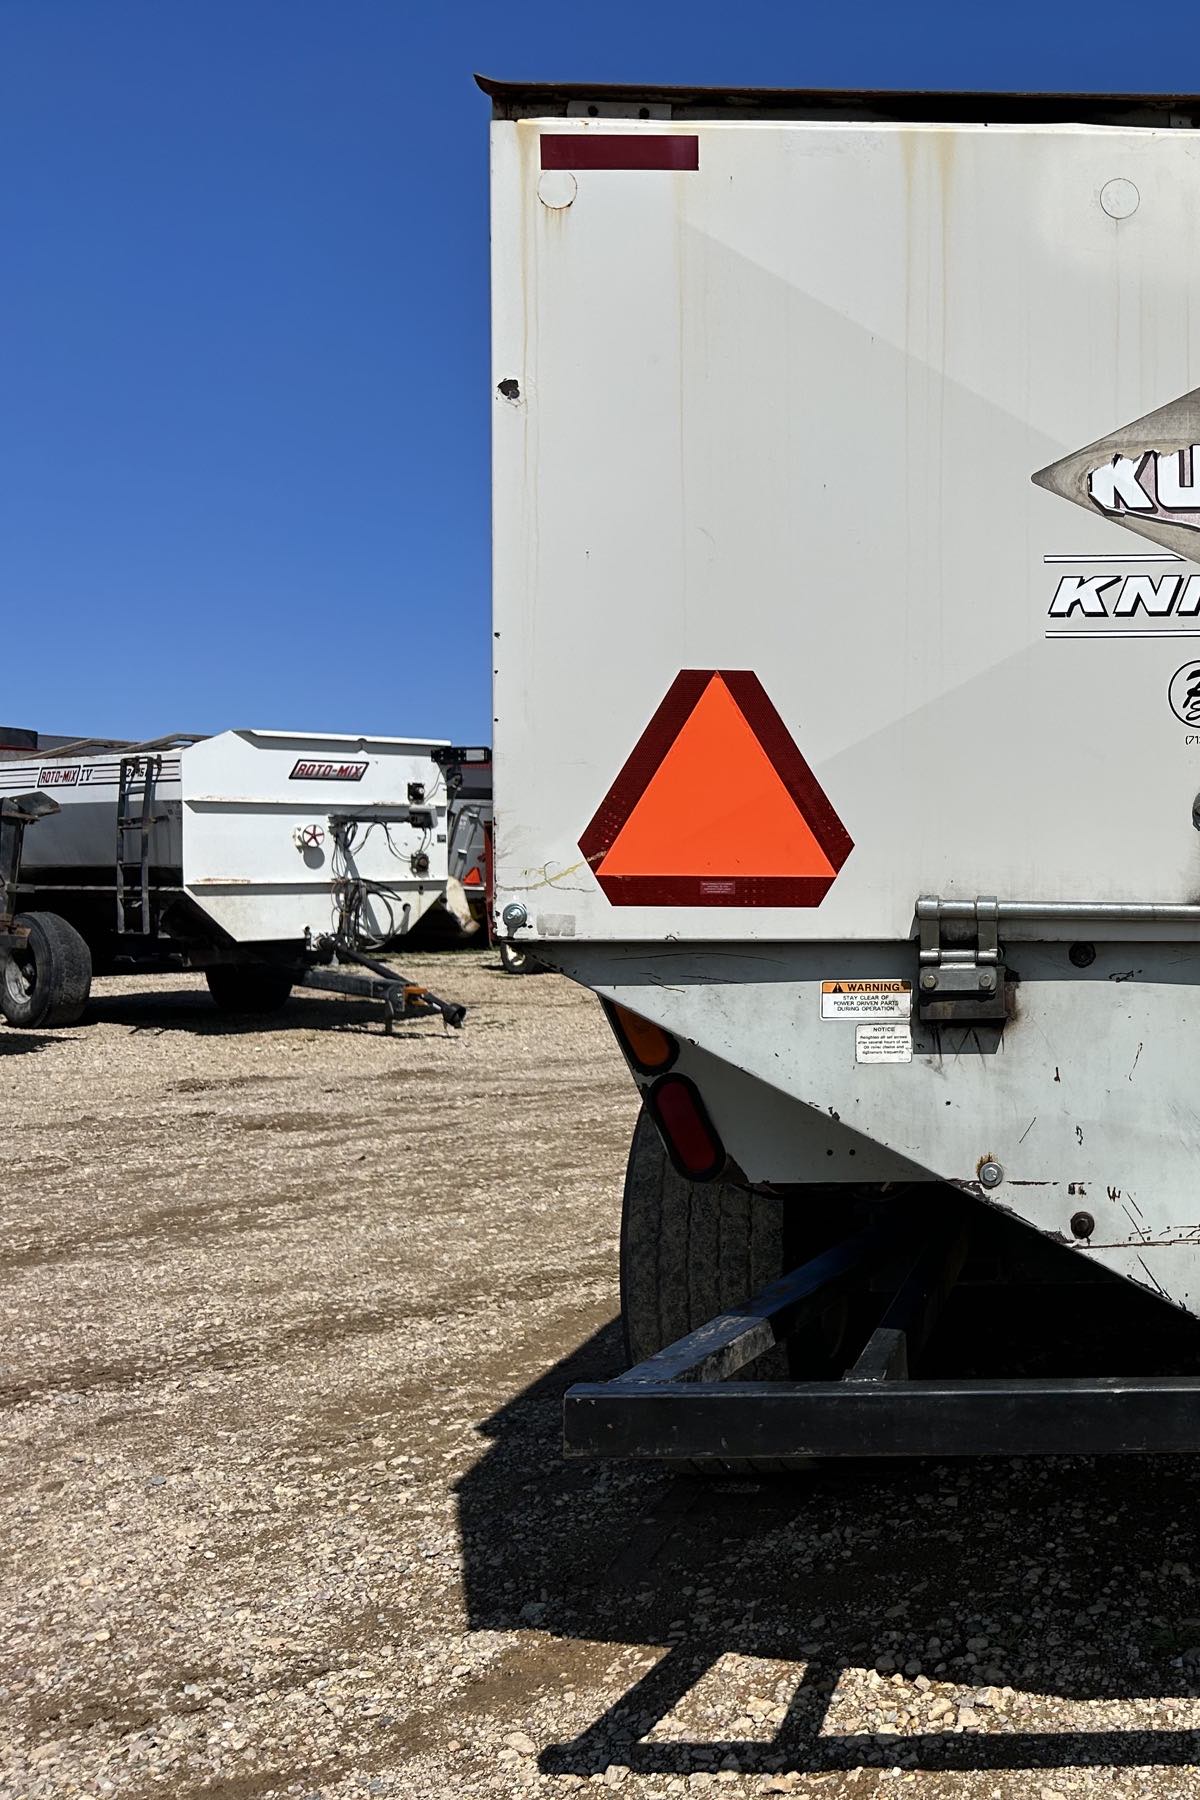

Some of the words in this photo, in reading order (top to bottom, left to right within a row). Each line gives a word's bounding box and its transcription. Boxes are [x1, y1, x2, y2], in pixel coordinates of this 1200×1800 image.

[40, 768, 78, 784] ROTO-MIX
[296, 763, 363, 778] ROTO-MIX
[847, 983, 900, 991] WARNING
